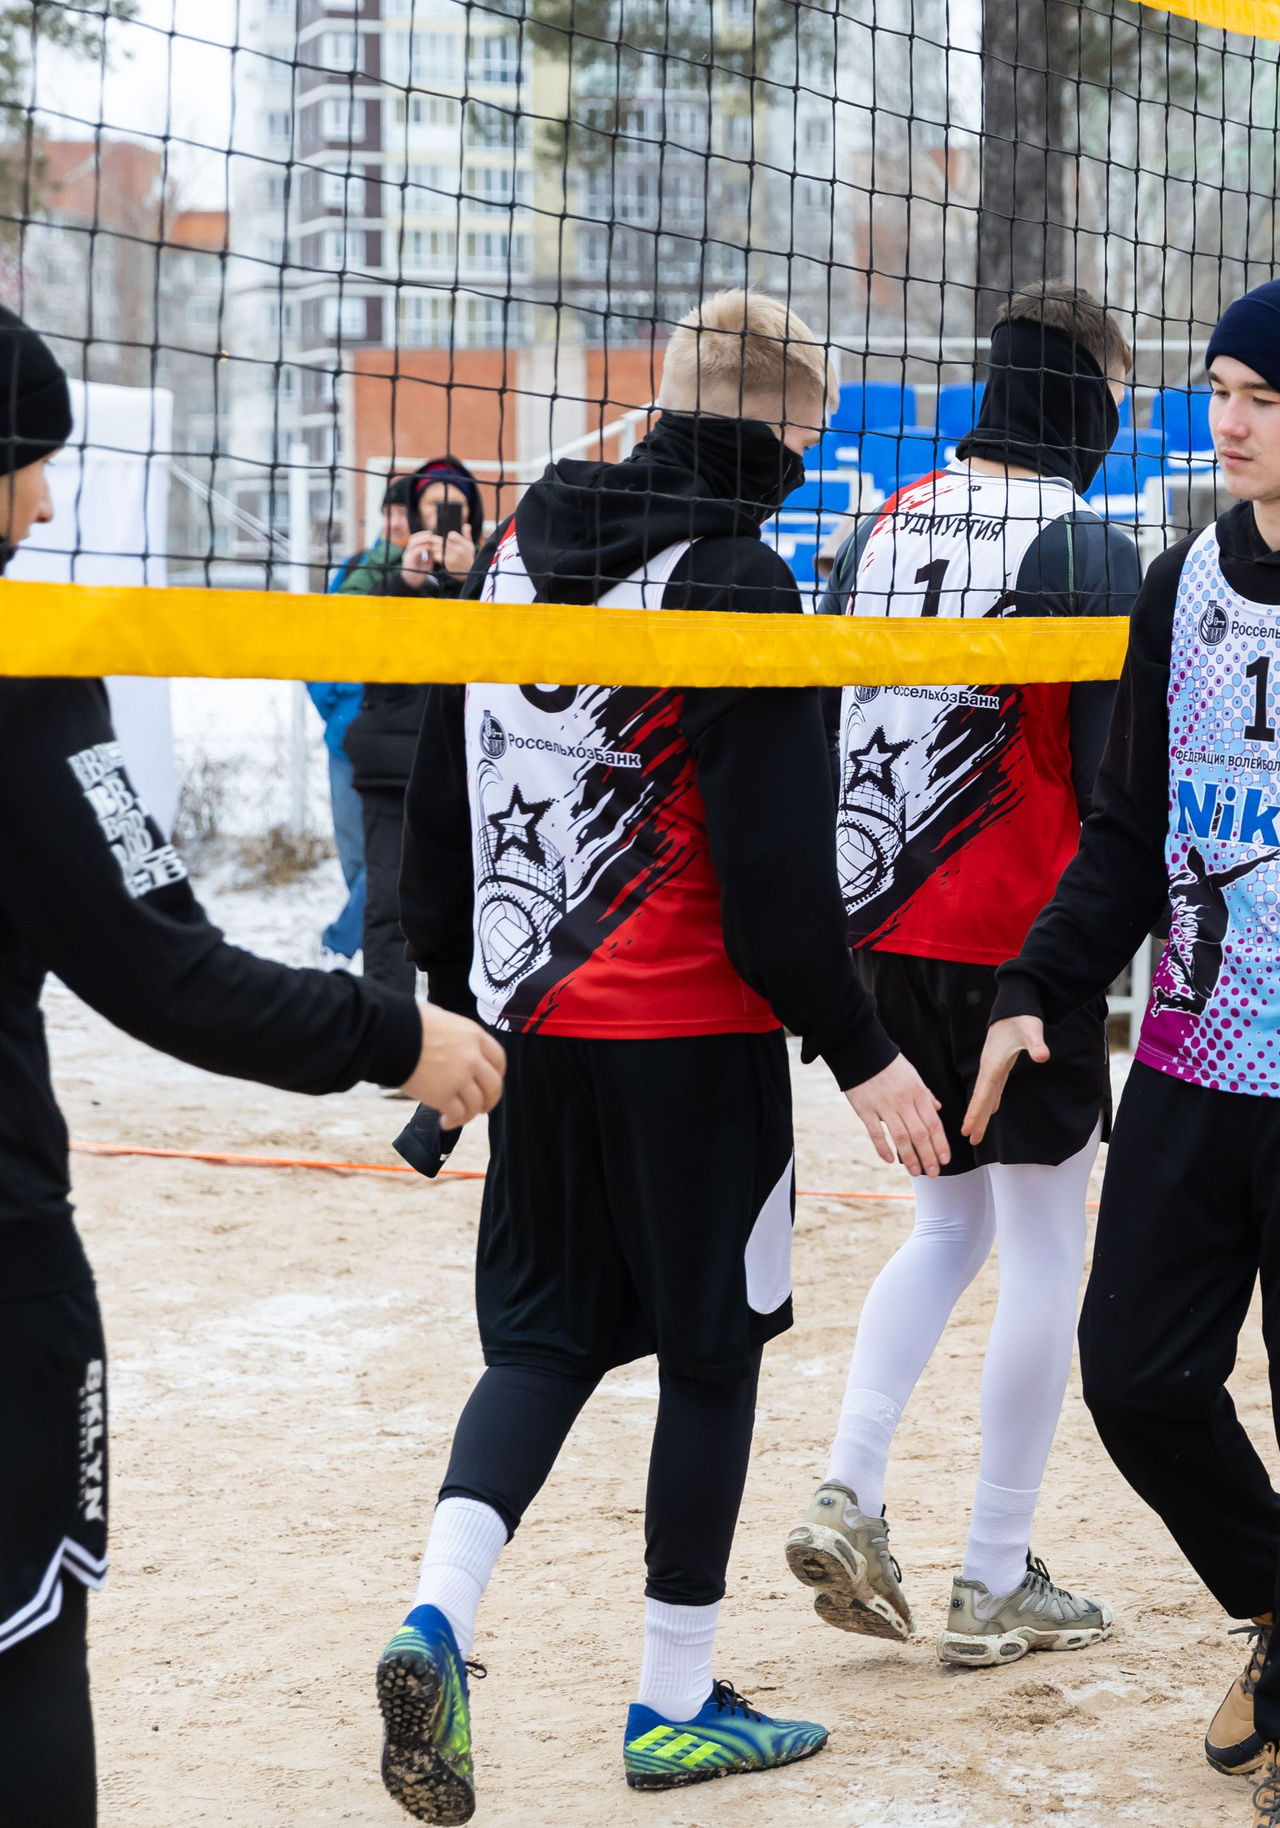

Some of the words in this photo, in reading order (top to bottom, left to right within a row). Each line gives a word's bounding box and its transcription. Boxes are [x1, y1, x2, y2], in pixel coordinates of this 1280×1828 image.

[900, 512, 1006, 541] УДМУРТИЯ
[914, 558, 950, 617] 1
[1244, 656, 1275, 742] 1
[508, 733, 641, 767] РоссельхозБанк
[1175, 750, 1225, 766] ФЕДЕРАЦИЯ
